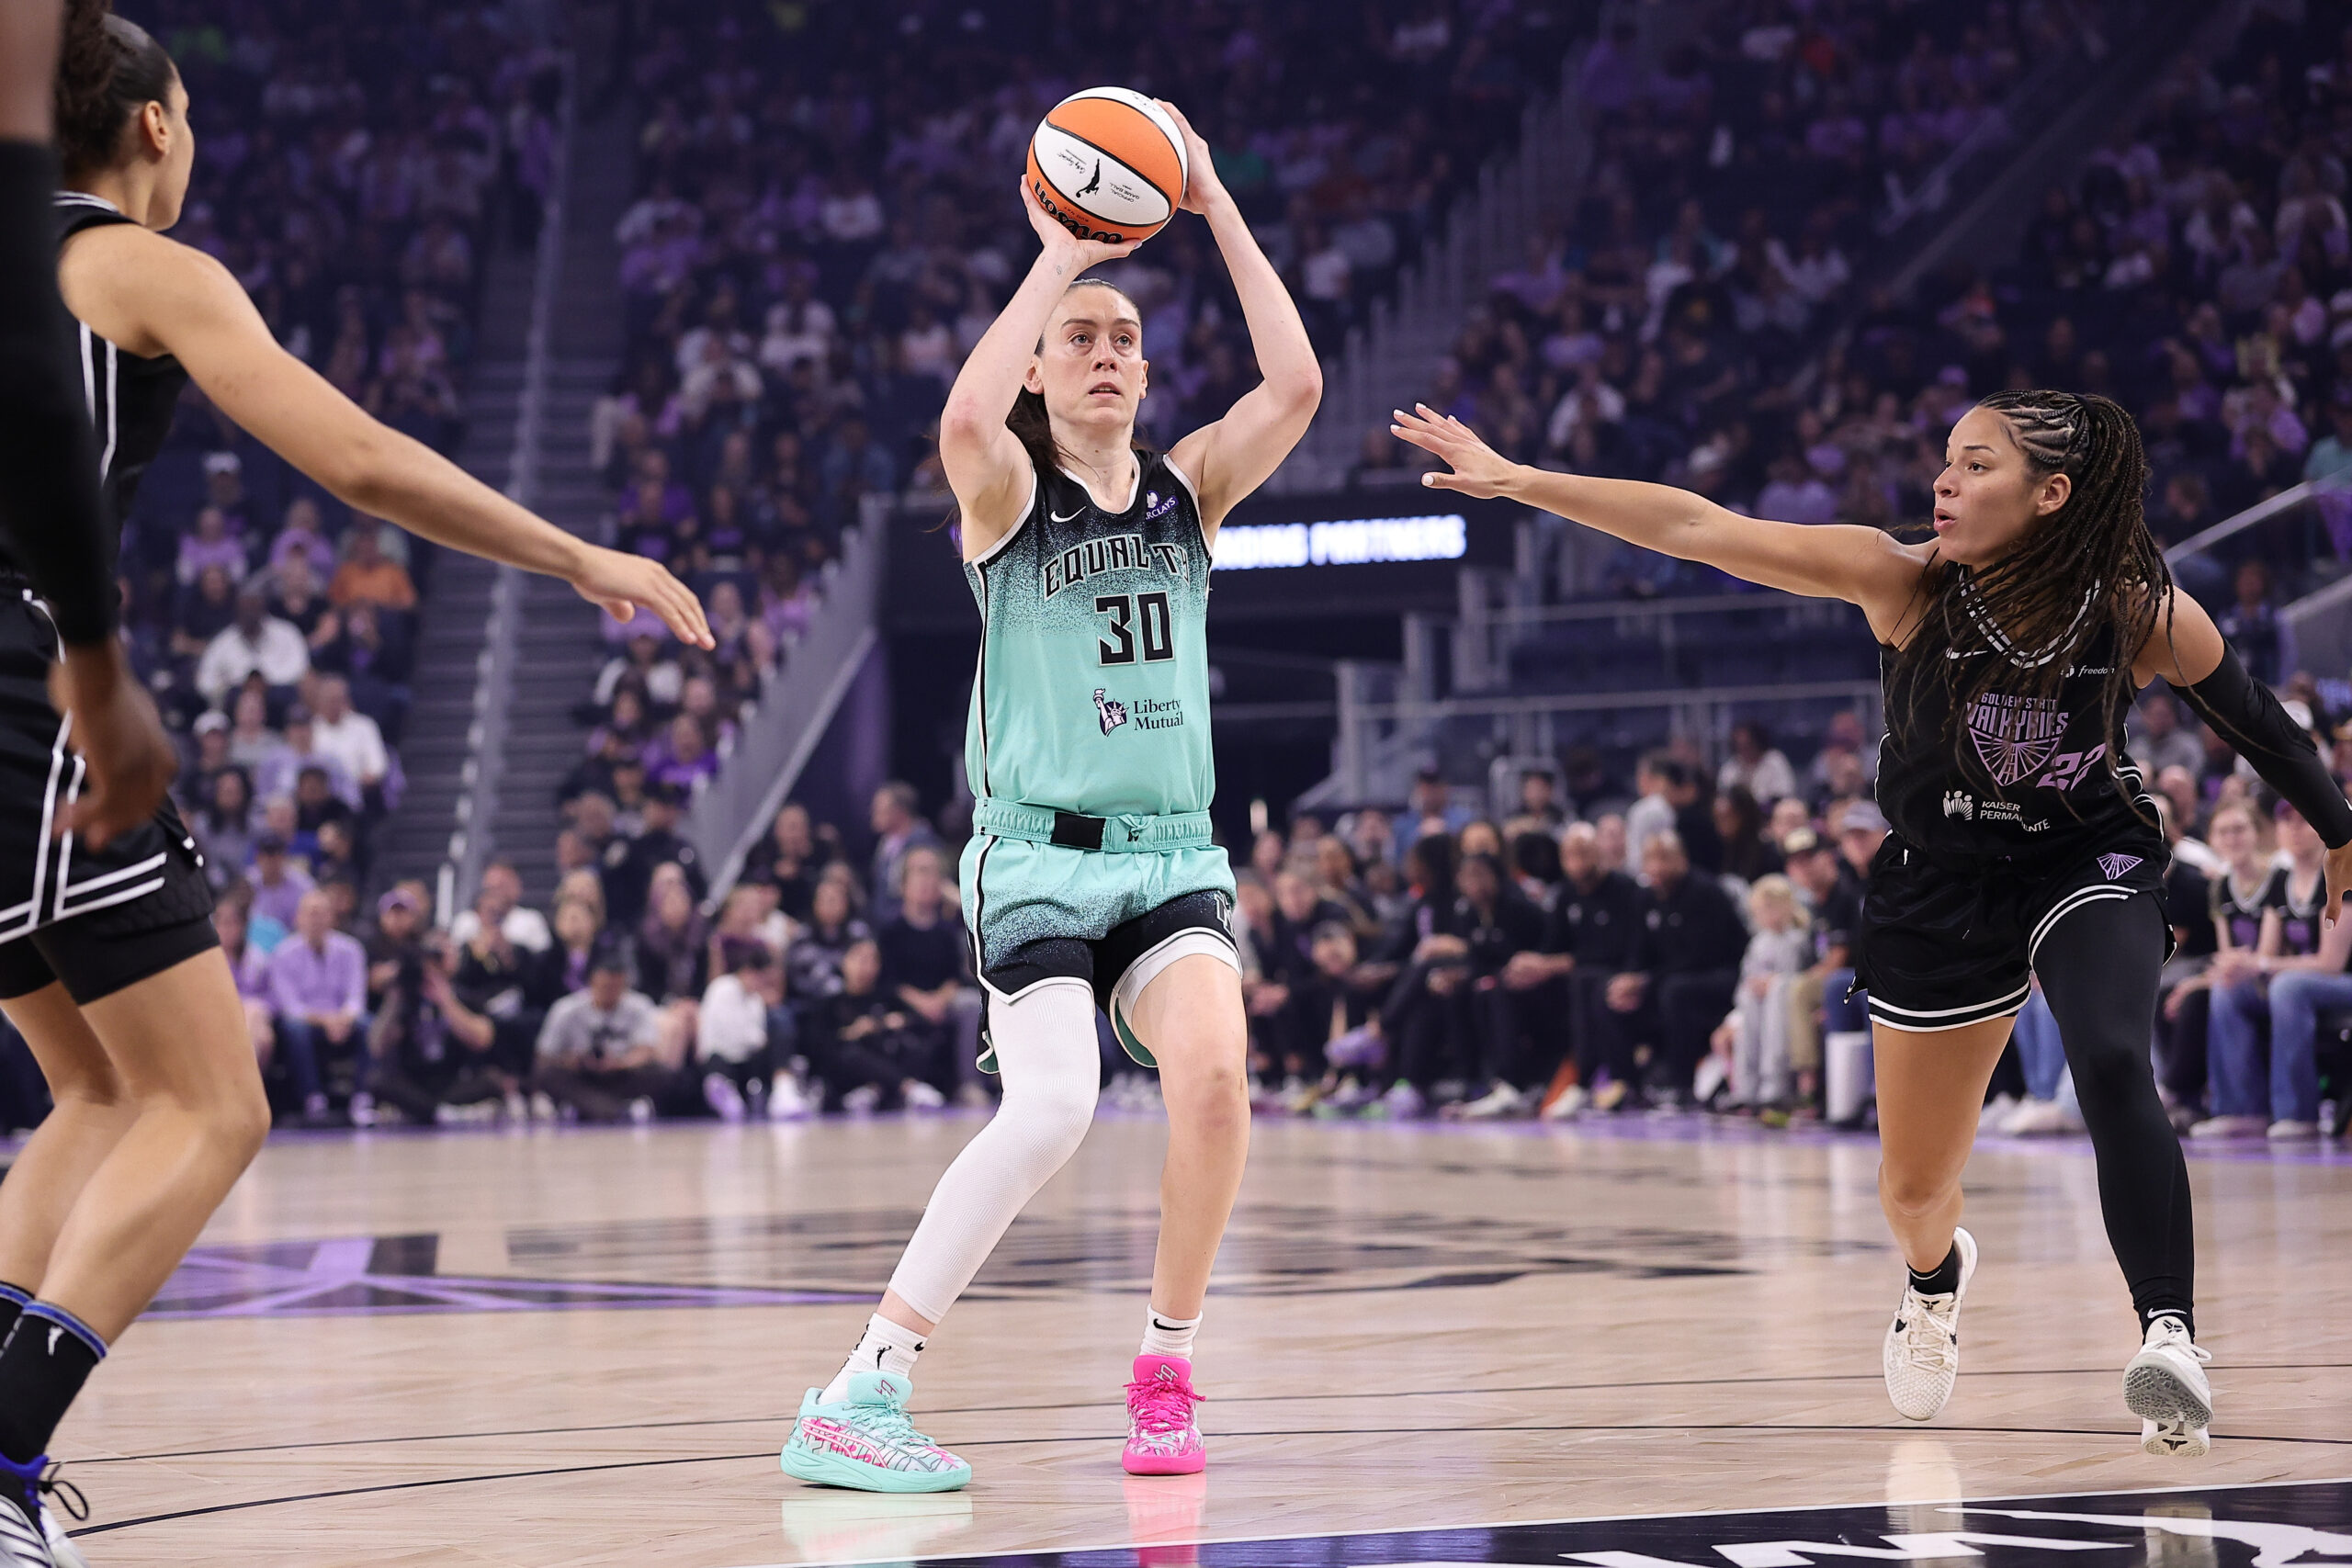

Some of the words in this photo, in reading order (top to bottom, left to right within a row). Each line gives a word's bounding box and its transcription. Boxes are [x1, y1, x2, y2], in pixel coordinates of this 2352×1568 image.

[1110, 183, 1124, 193] BALL
[1111, 188, 1135, 203] OFFICIAL
[1124, 189, 1140, 200] GAME
[1146, 497, 1176, 521] RCLAYS
[1044, 534, 1190, 603] EQUALTY
[1094, 591, 1175, 668] 30
[2077, 664, 2115, 678] freedo
[1133, 698, 1182, 716] Liberty
[1134, 713, 1183, 731] Mutual
[1982, 800, 2021, 812] KAISER
